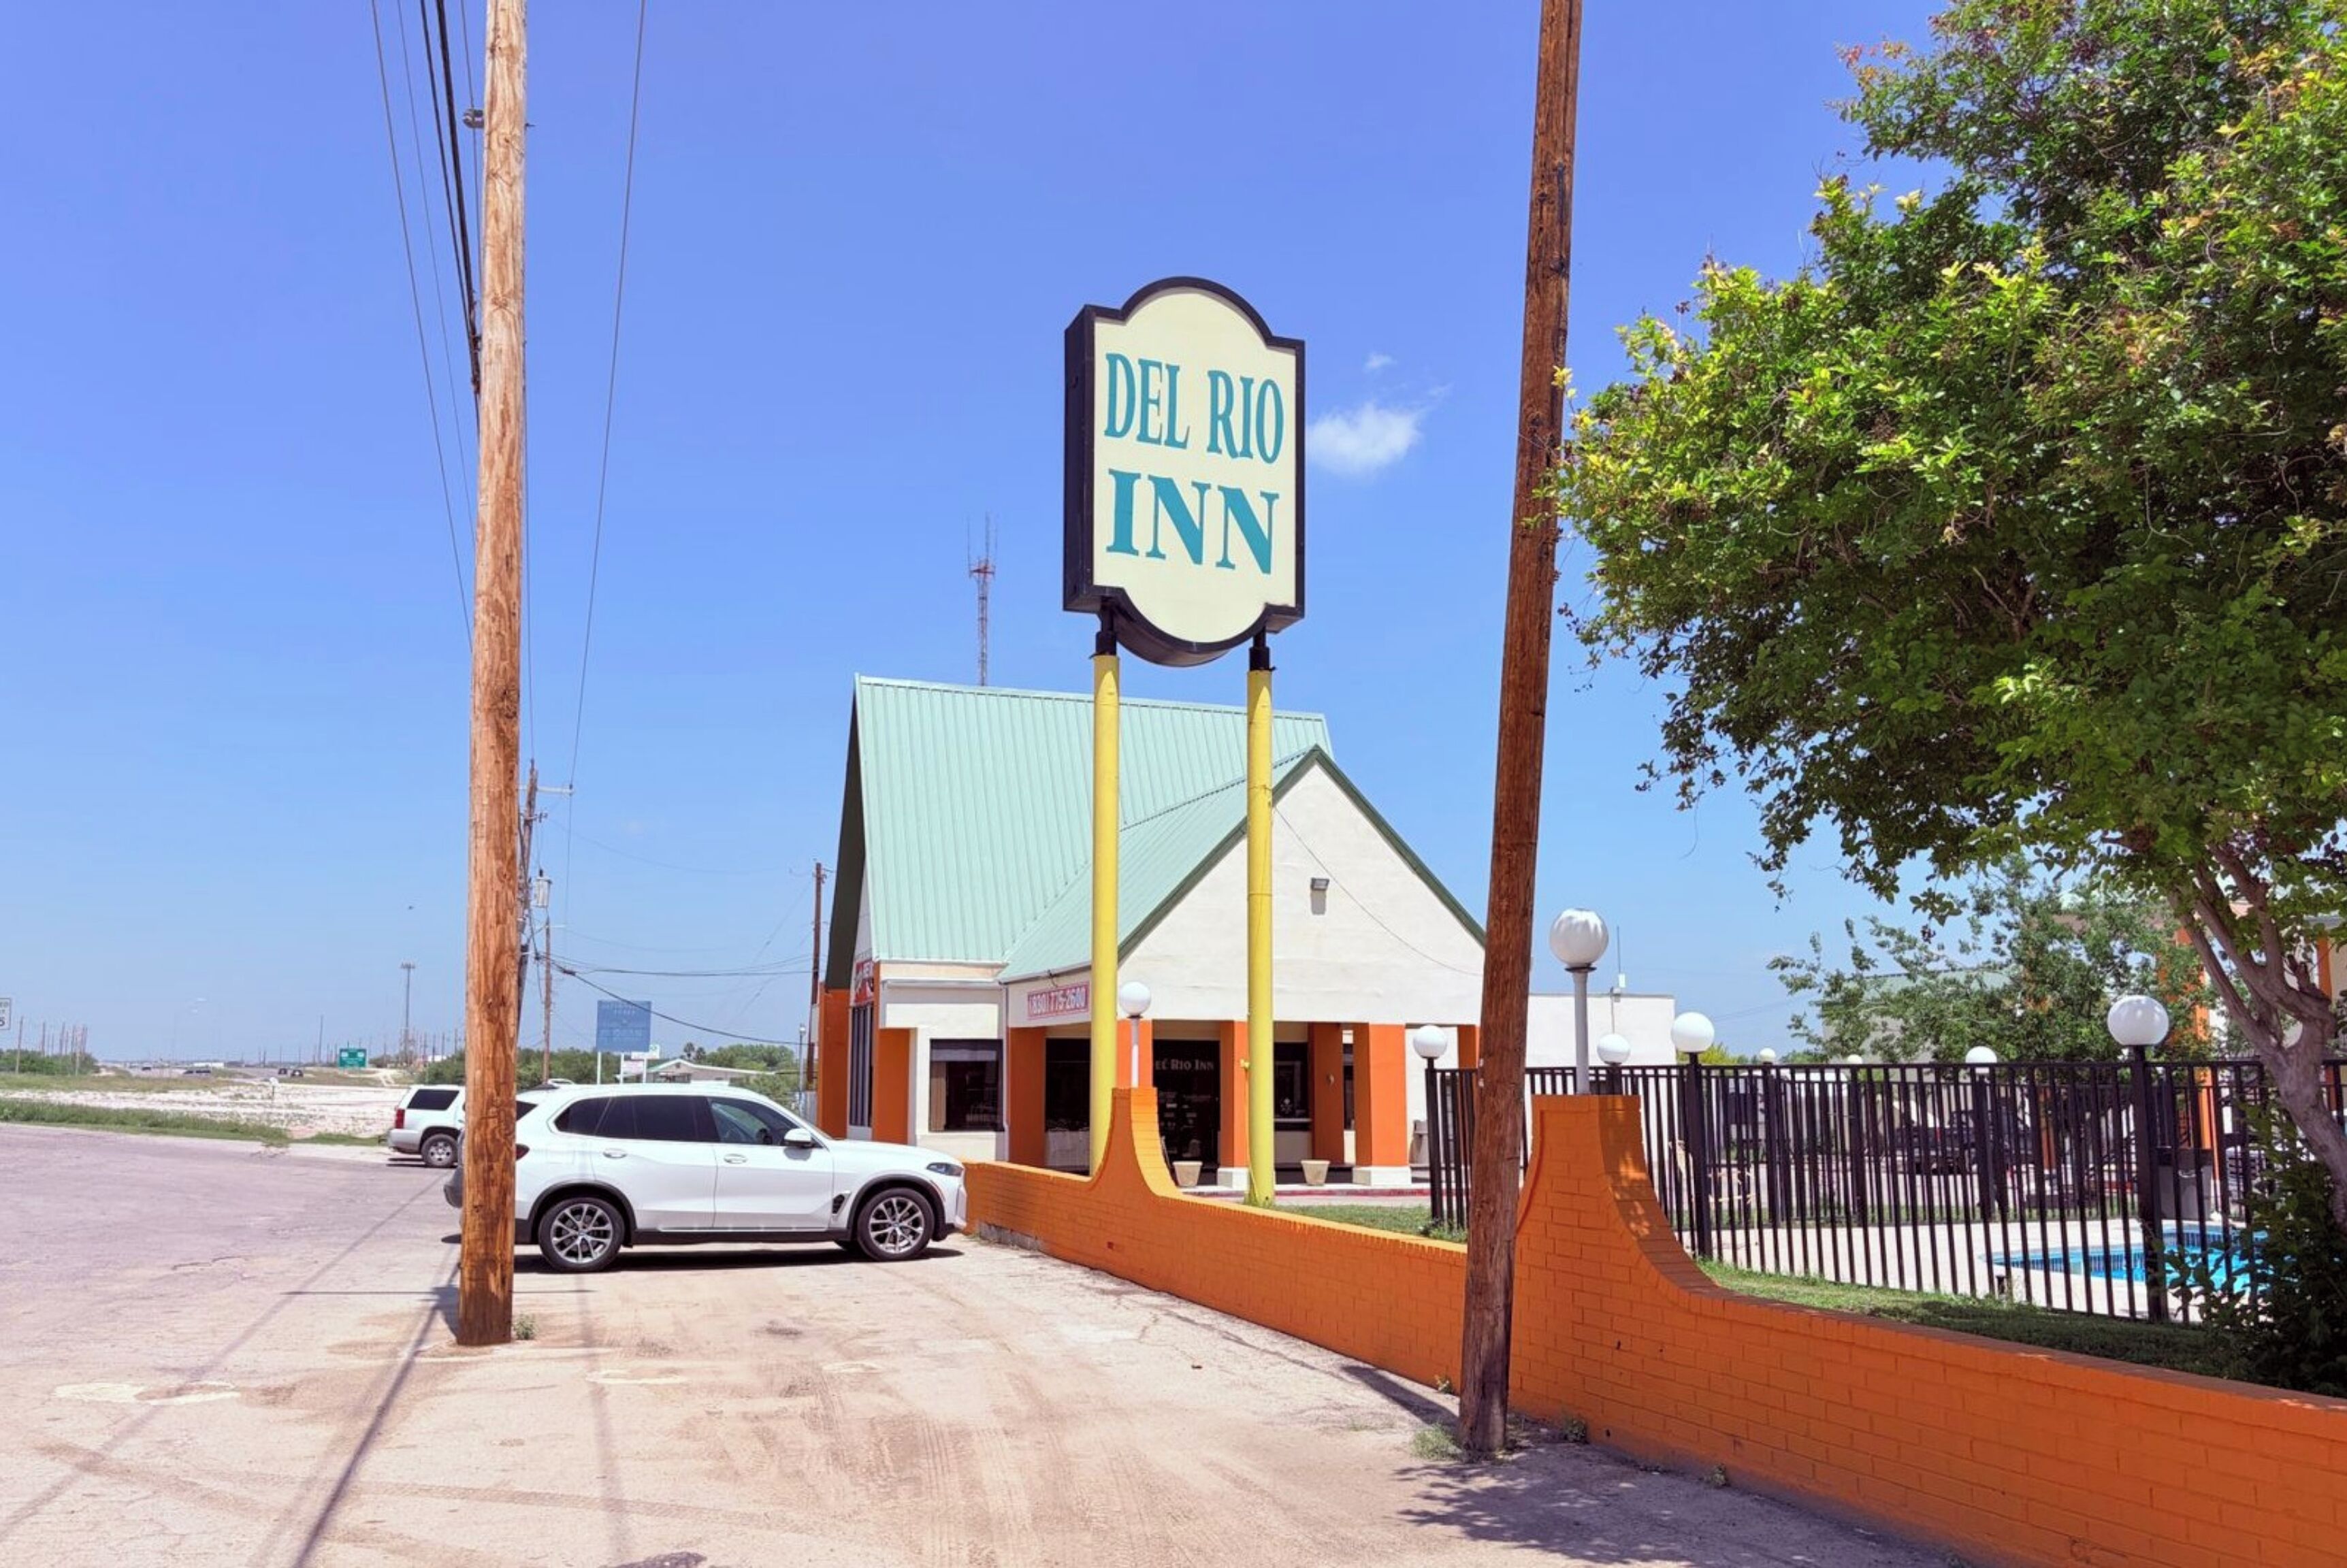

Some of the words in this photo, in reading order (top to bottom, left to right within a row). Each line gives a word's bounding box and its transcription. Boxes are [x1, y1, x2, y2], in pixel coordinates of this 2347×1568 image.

[1104, 352, 1190, 450] DEL
[1207, 370, 1284, 464] RIO
[1105, 468, 1280, 575] INN
[1195, 1059, 1214, 1071] INN
